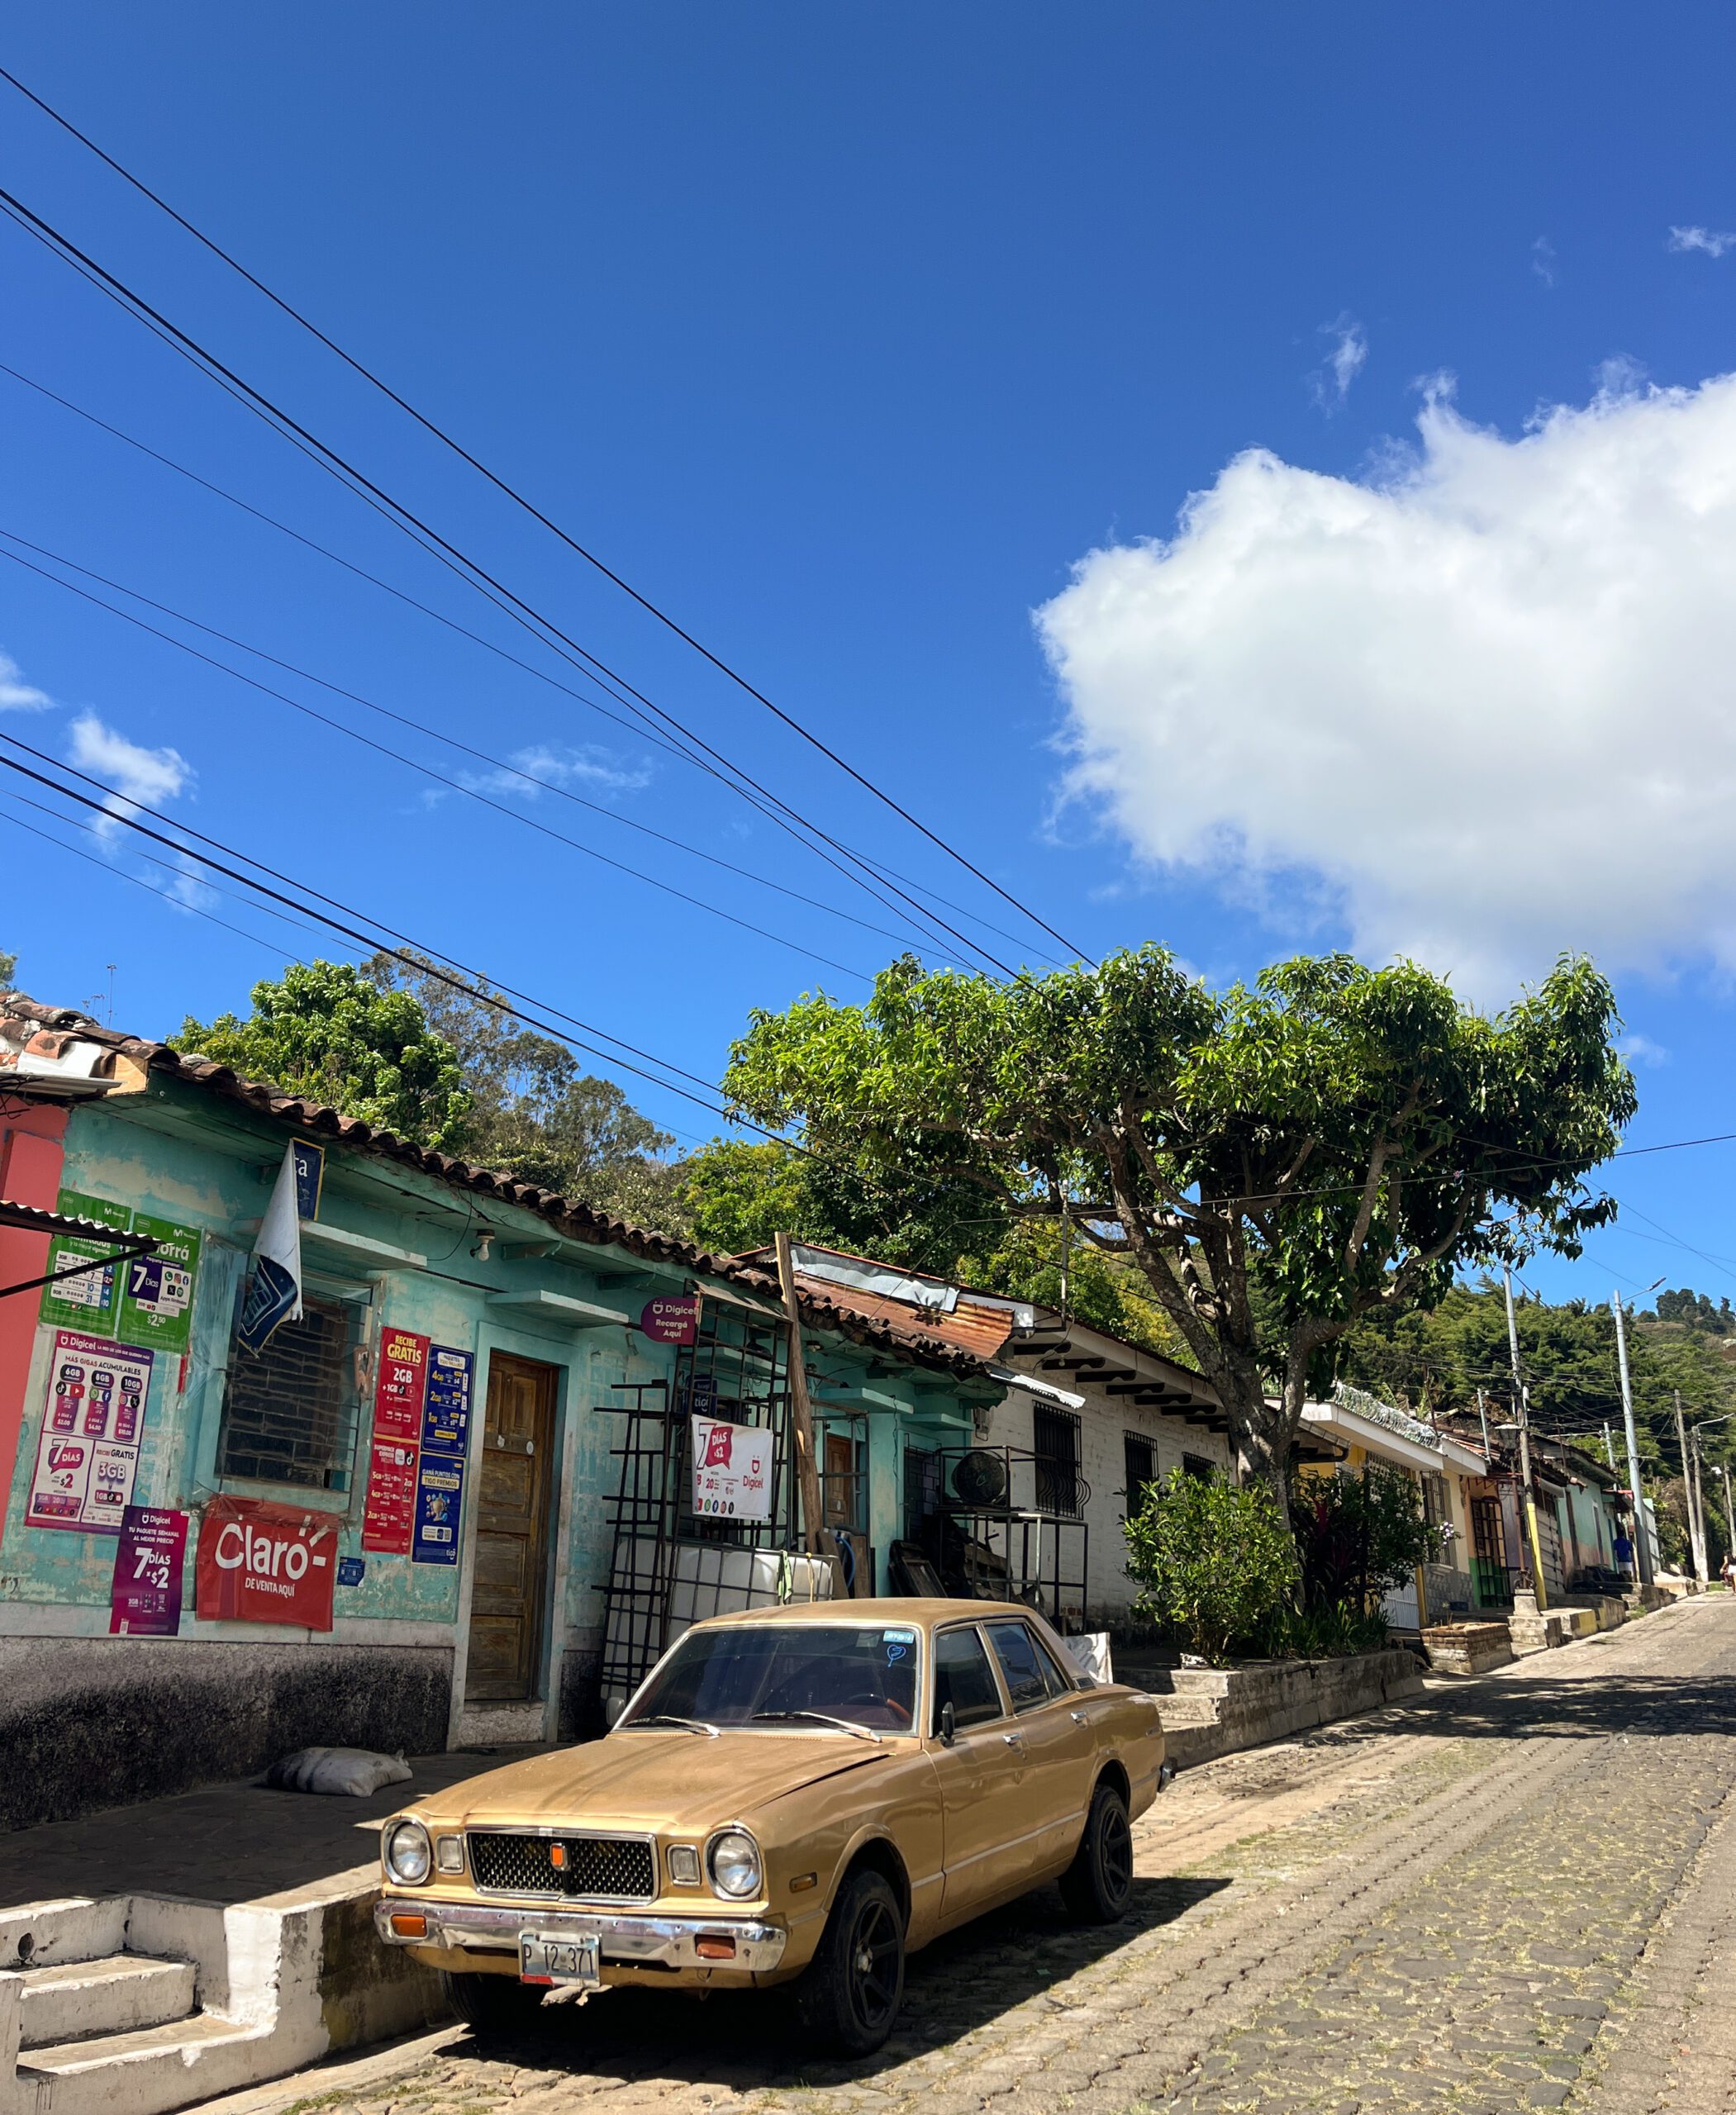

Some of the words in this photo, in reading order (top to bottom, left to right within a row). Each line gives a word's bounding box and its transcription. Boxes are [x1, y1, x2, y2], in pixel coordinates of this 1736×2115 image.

[132, 1265, 147, 1293] 7
[145, 1276, 159, 1288] Días
[87, 1283, 94, 1292] 10
[85, 1295, 93, 1304] 31
[655, 1319, 688, 1330] Recargá
[69, 1337, 97, 1350] Digicel
[395, 1334, 417, 1348] RECIBE
[387, 1343, 422, 1365] GRATIS
[64, 1355, 78, 1363] MÁS
[79, 1357, 98, 1367] GIGAS
[98, 1362, 141, 1376] ACUMULABLES
[65, 1367, 81, 1377] 6GB
[95, 1373, 110, 1383] 8GB
[393, 1366, 413, 1384] 2GB
[125, 1378, 140, 1389] 10GB
[711, 1431, 728, 1446] DÍAS
[51, 1438, 69, 1465] 7
[697, 1423, 717, 1470] 7
[61, 1452, 81, 1462] DÍAS
[111, 1448, 135, 1460] GRATIS
[98, 1461, 126, 1481] 3GB
[435, 1471, 451, 1479] PUNTOS
[59, 1473, 74, 1489] $2
[424, 1477, 437, 1485] TIGO
[436, 1479, 458, 1488] PREMIOS
[706, 1477, 715, 1490] 20
[743, 1475, 764, 1490] Digicel
[150, 1514, 171, 1525] Digicel
[136, 1528, 157, 1536] PAQUETE
[158, 1529, 180, 1538] SEMANAL
[133, 1547, 153, 1579] 7
[149, 1552, 171, 1566] DÍAS
[245, 1577, 255, 1589] DE
[255, 1578, 278, 1595] VENTA
[278, 1584, 296, 1599] AQUÍ
[521, 1943, 532, 1970] P
[545, 1944, 559, 1971] 12
[568, 1946, 593, 1975] 371
